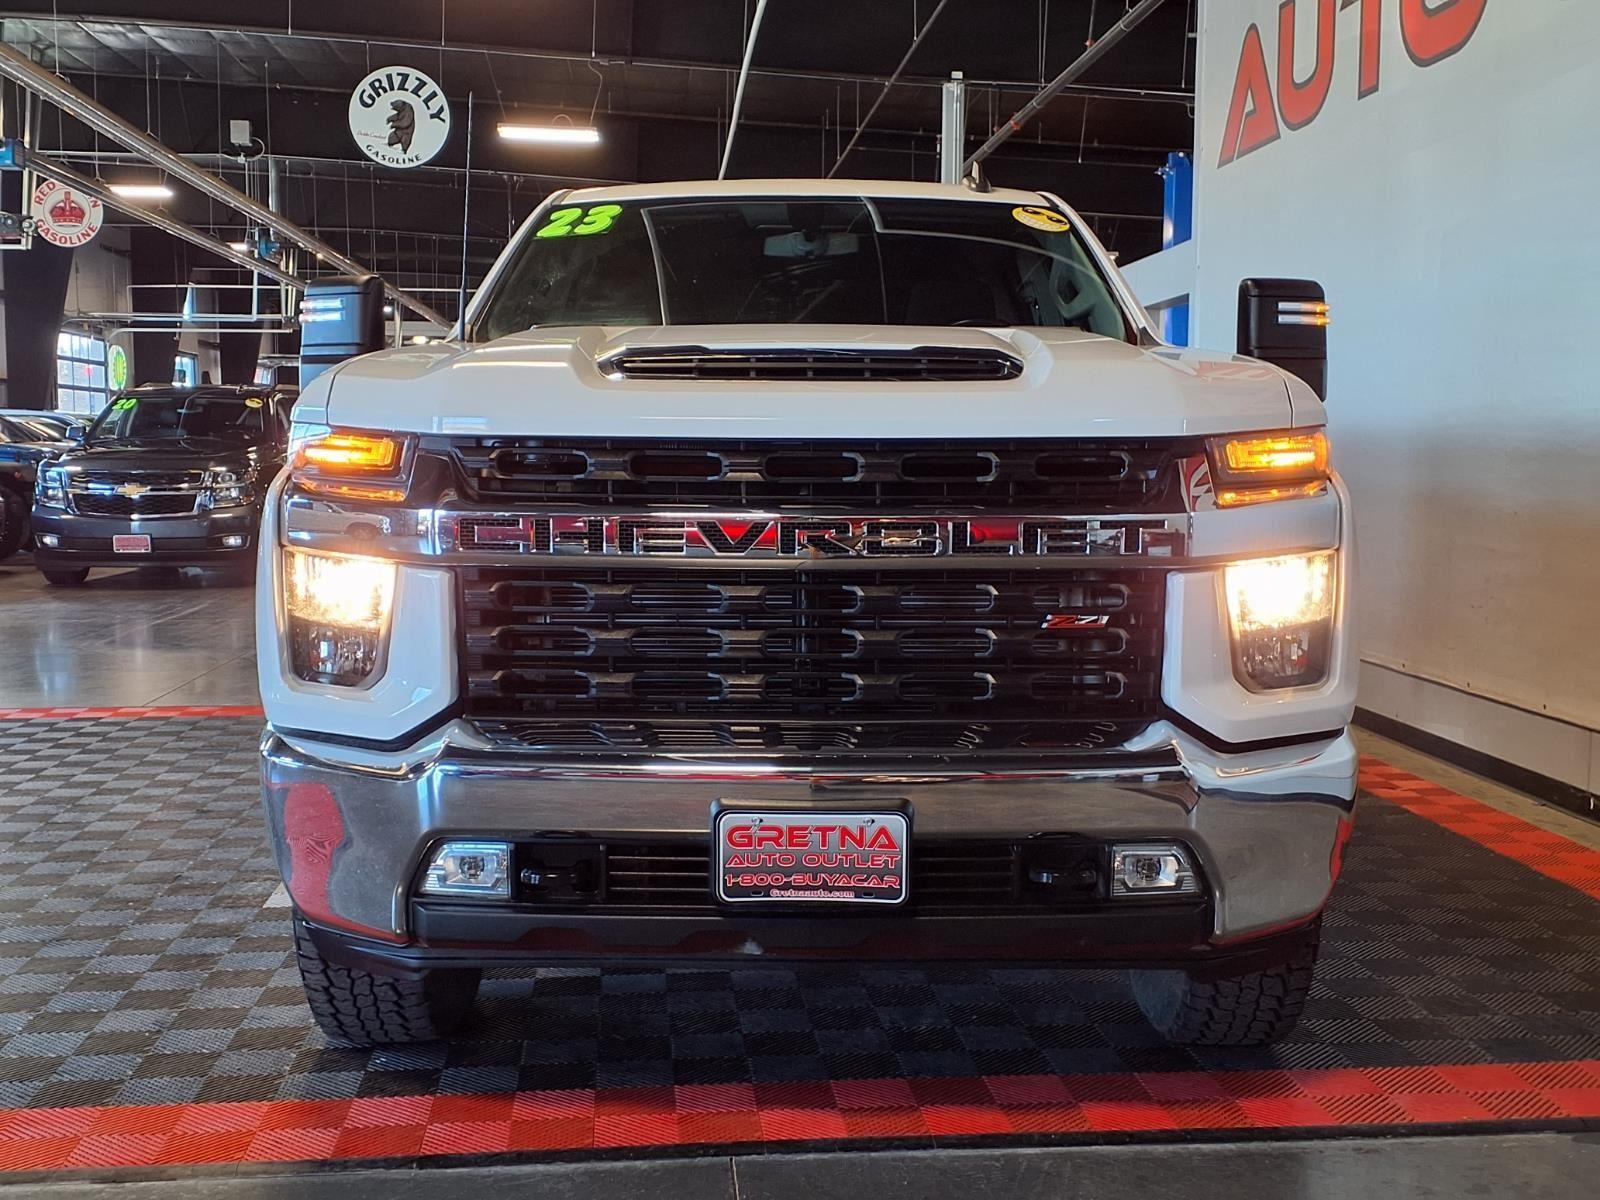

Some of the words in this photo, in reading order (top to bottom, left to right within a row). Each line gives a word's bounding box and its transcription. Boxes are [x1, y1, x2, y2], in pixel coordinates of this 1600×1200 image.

[358, 72, 446, 124] GRIZZLY
[365, 143, 422, 165] GASOLINE
[33, 180, 56, 206] RED
[35, 217, 98, 245] GASOLINE
[536, 204, 623, 238] 23
[111, 398, 137, 410] 20
[458, 516, 1168, 555] CHEVROLET
[1040, 613, 1110, 629] Z71
[725, 824, 900, 851] GRETNA
[725, 852, 796, 868] AUTO
[802, 852, 901, 869] OUTLET
[725, 872, 901, 889] 1-800-BUYACAR
[769, 887, 856, 899] Gretnaauto.com
